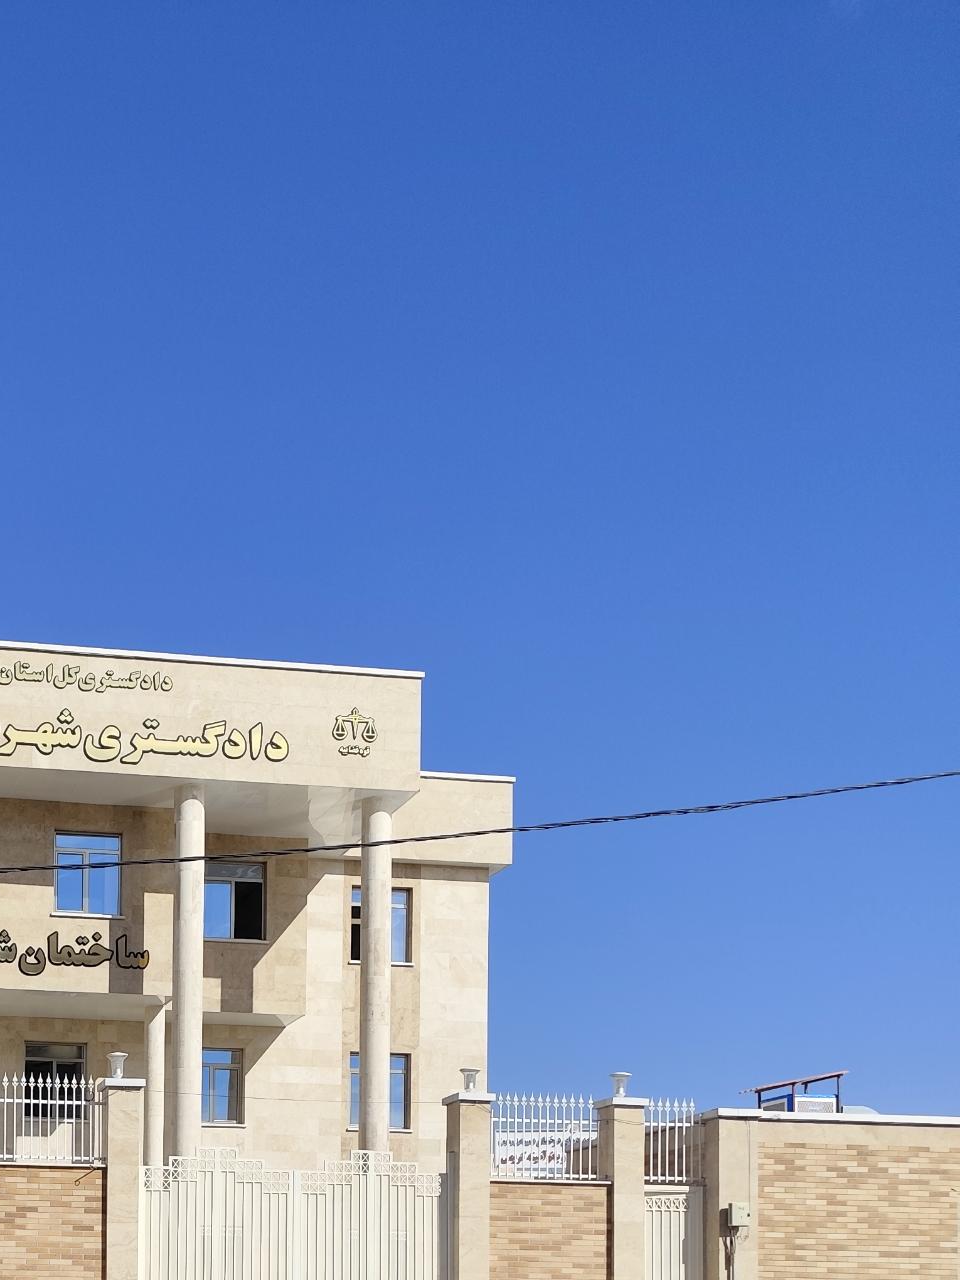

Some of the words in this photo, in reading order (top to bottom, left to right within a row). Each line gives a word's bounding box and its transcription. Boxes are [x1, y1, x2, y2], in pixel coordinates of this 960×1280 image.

[53, 663, 80, 690] کل
[78, 667, 174, 693] دادگستری
[83, 717, 290, 766] دادگستری
[18, 930, 150, 977] ساختمان
